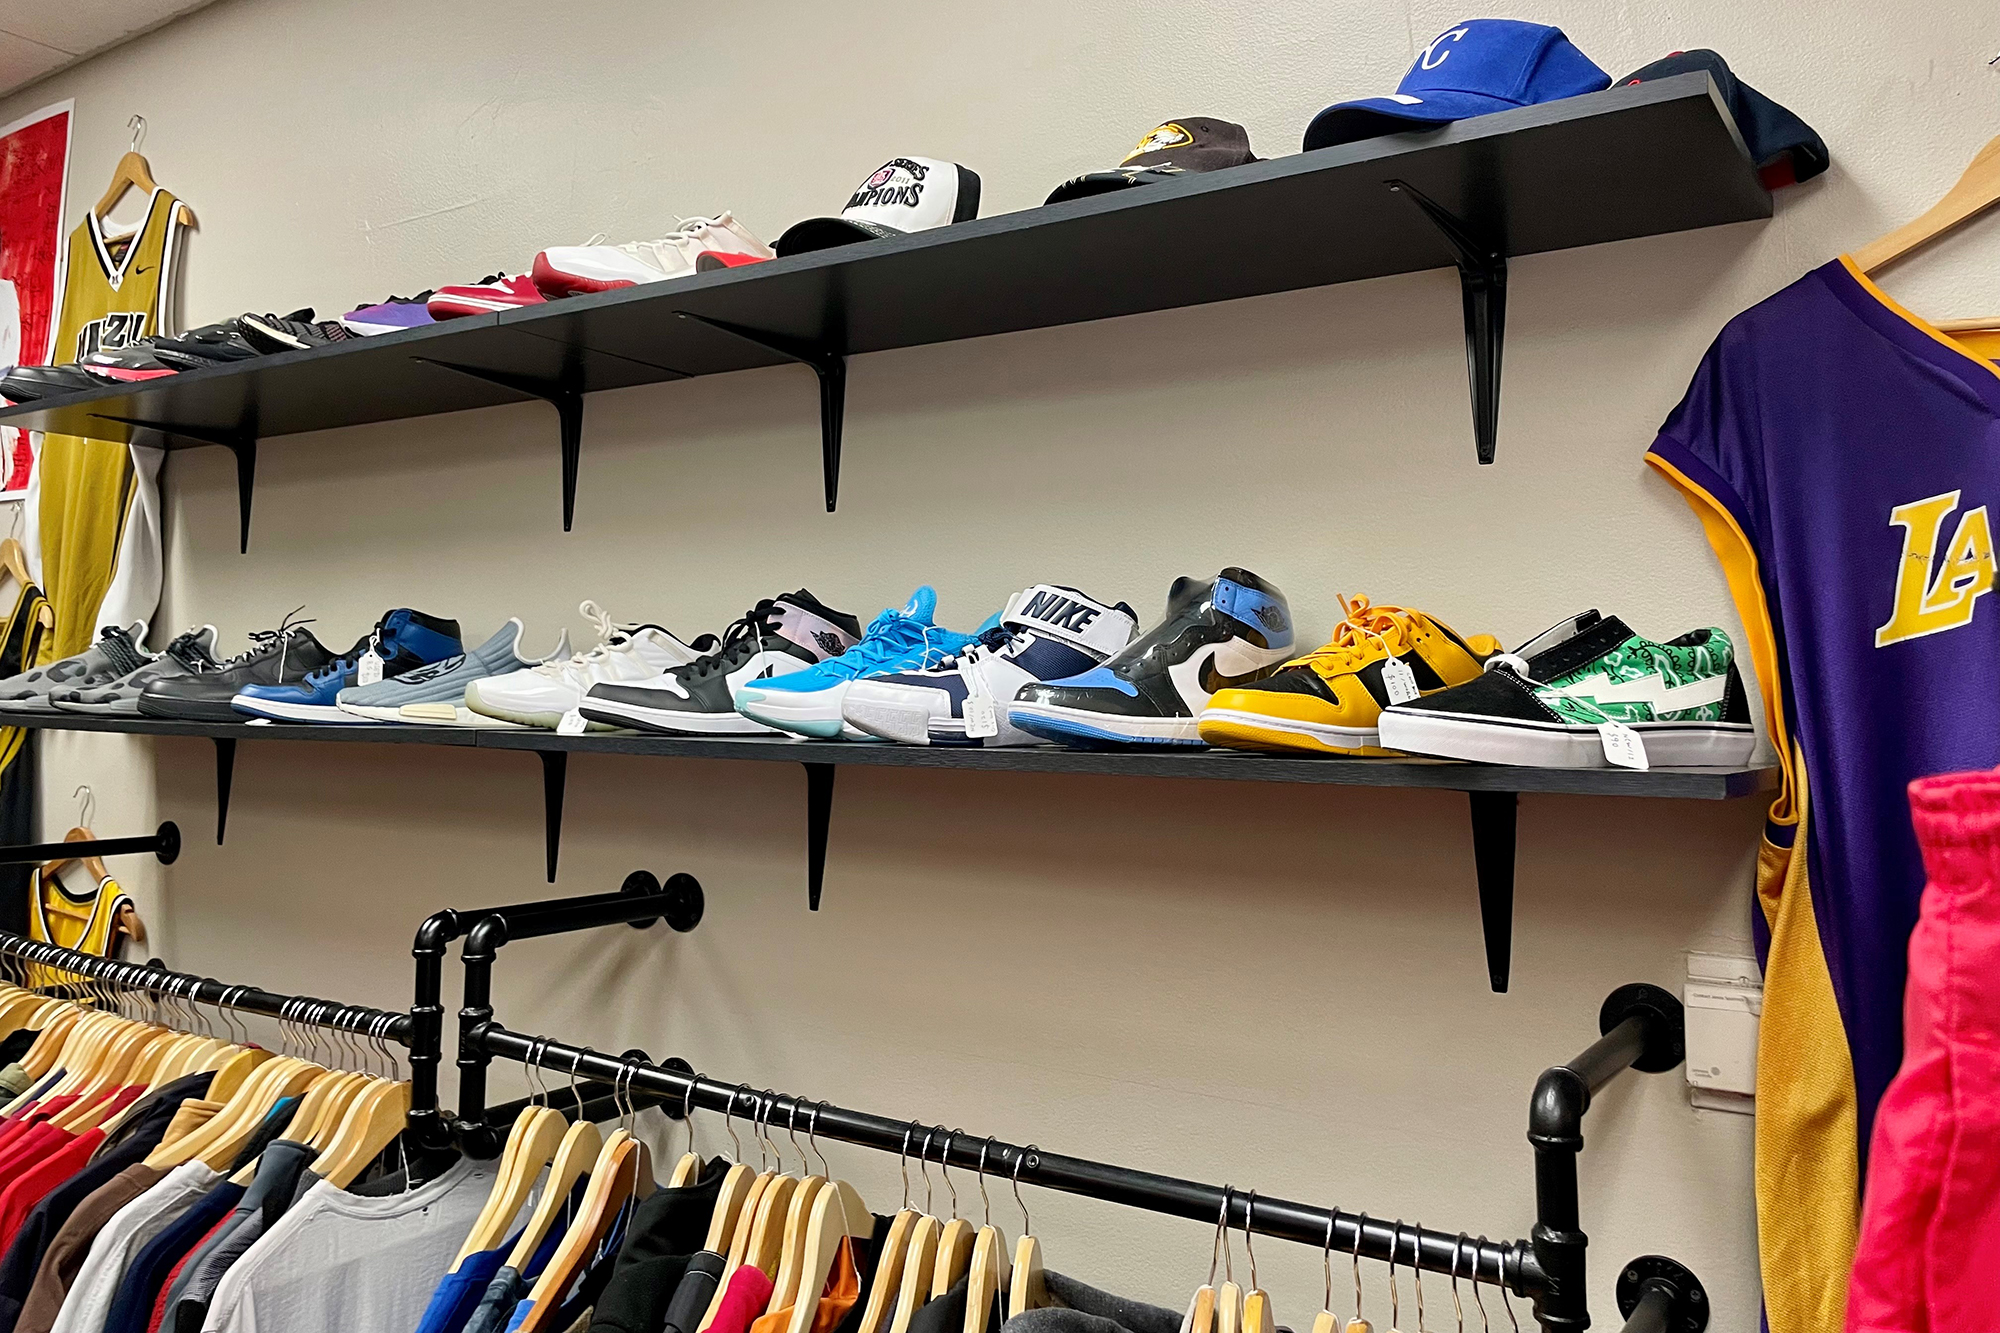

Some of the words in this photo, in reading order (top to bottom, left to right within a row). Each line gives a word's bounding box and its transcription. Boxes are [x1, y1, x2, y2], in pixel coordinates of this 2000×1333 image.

[890, 176, 910, 184] 2011
[1875, 489, 1998, 648] LA
[1020, 591, 1101, 634] NIKE
[1385, 674, 1399, 695] $100
